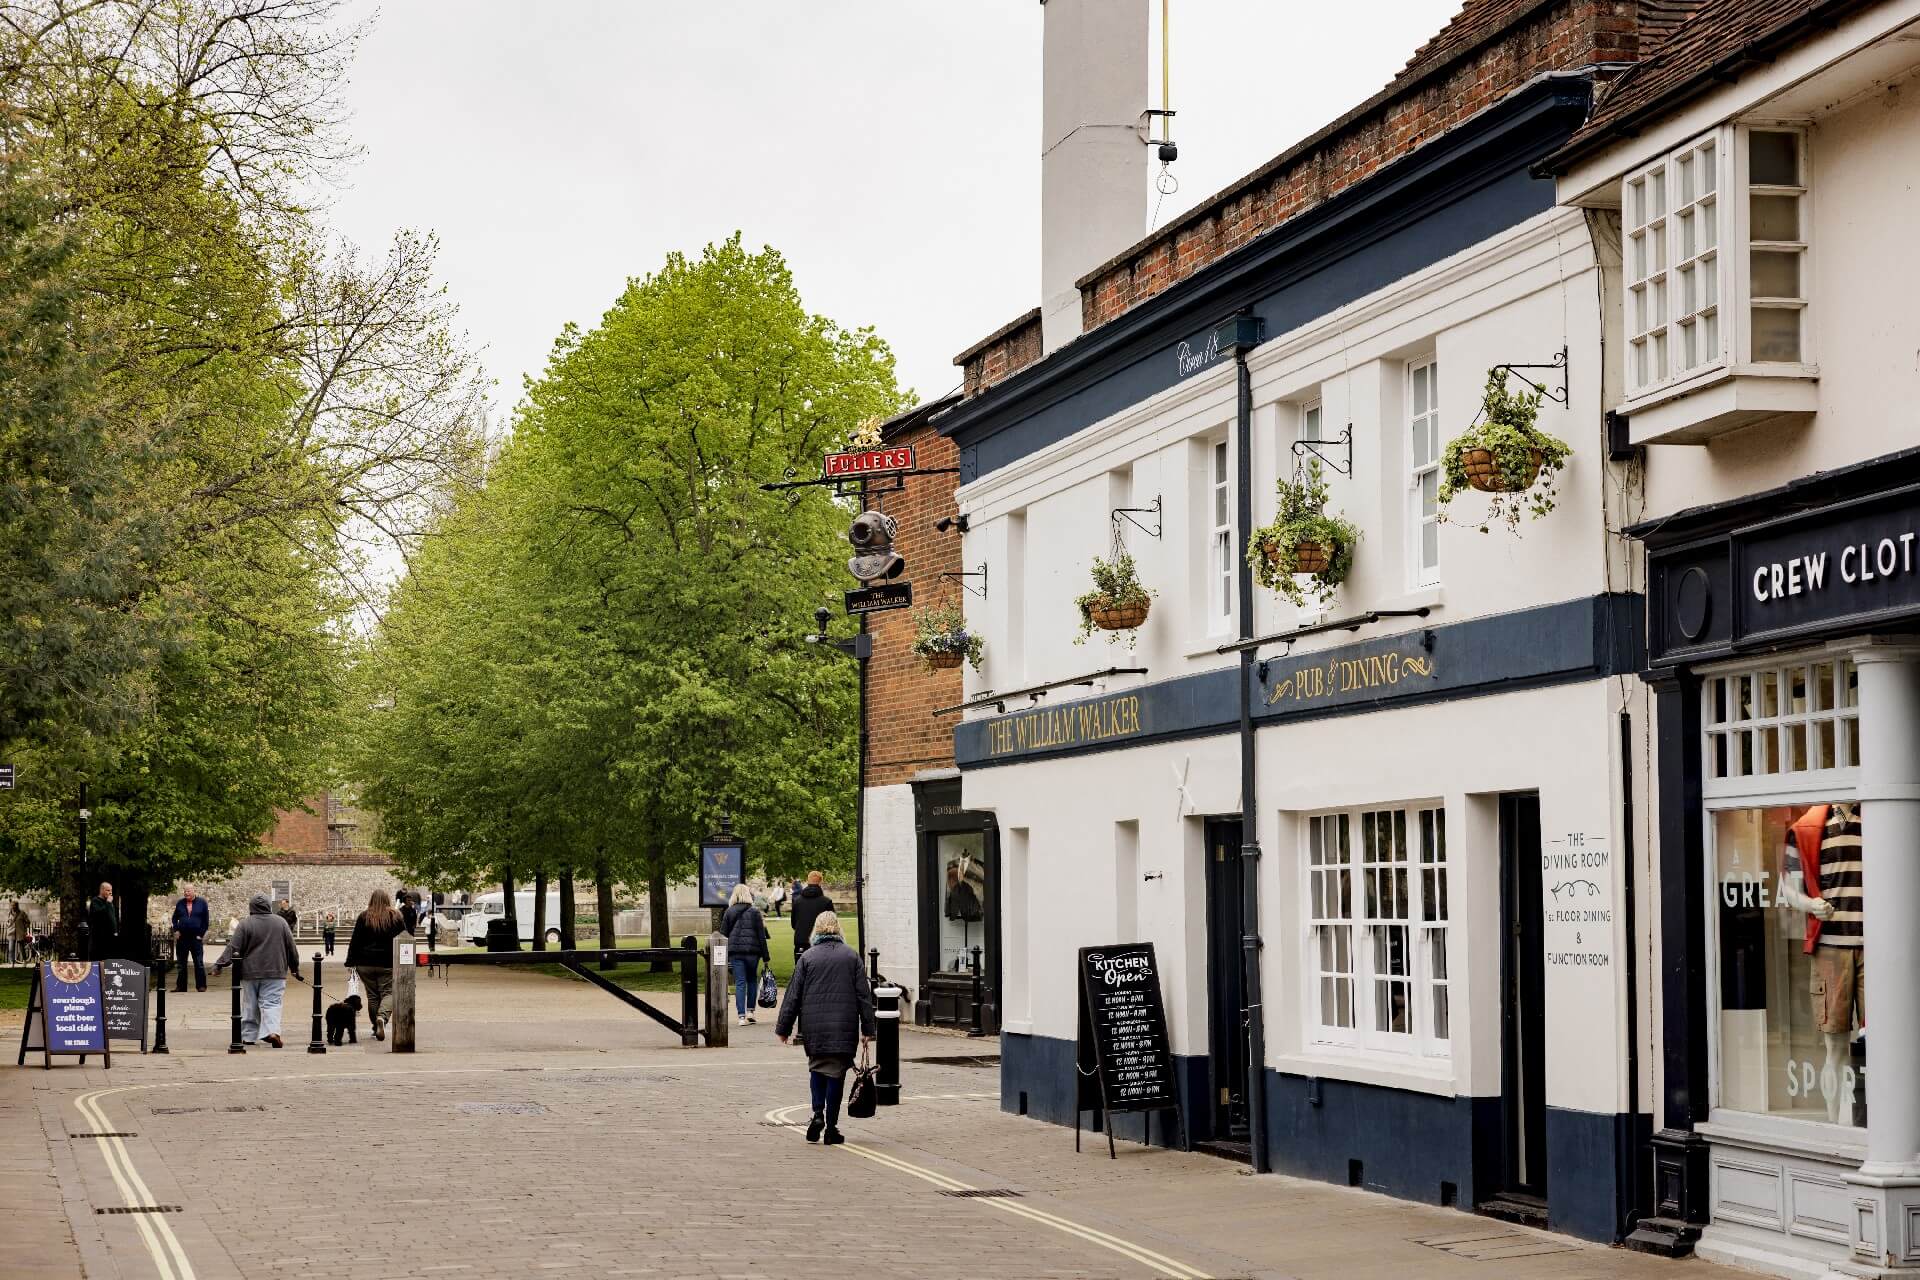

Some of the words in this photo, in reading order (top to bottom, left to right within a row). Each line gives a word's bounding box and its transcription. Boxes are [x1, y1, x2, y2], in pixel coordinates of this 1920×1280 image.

[829, 450, 905, 472] FULLER'S
[1753, 552, 1826, 602] CREW
[1841, 532, 1915, 583] CLOT
[851, 599, 880, 609] WILLIAM
[880, 596, 907, 605] WALKER
[872, 592, 885, 600] THE
[1295, 666, 1324, 700] PUB
[1340, 652, 1399, 692] DINING
[989, 718, 1014, 755] THE
[1015, 707, 1076, 750] WILLIAM
[1077, 695, 1142, 743] WALKER
[1567, 832, 1585, 847] THE
[1543, 853, 1578, 870] DIVING
[1581, 851, 1609, 869] ROOM
[1723, 871, 1804, 908] GREAT
[1556, 910, 1581, 922] FLOOR
[1583, 910, 1611, 922] DINING
[1576, 931, 1582, 944] &
[1095, 956, 1149, 971] KITCHEN
[1547, 952, 1587, 967] FUNCTION
[1589, 952, 1609, 967] ROOM
[1104, 968, 1147, 988] Open
[52, 996, 96, 1006] sourdough
[55, 1014, 76, 1022] craft
[77, 1014, 95, 1022] beer
[55, 1024, 76, 1032] local
[76, 1024, 97, 1032] cider
